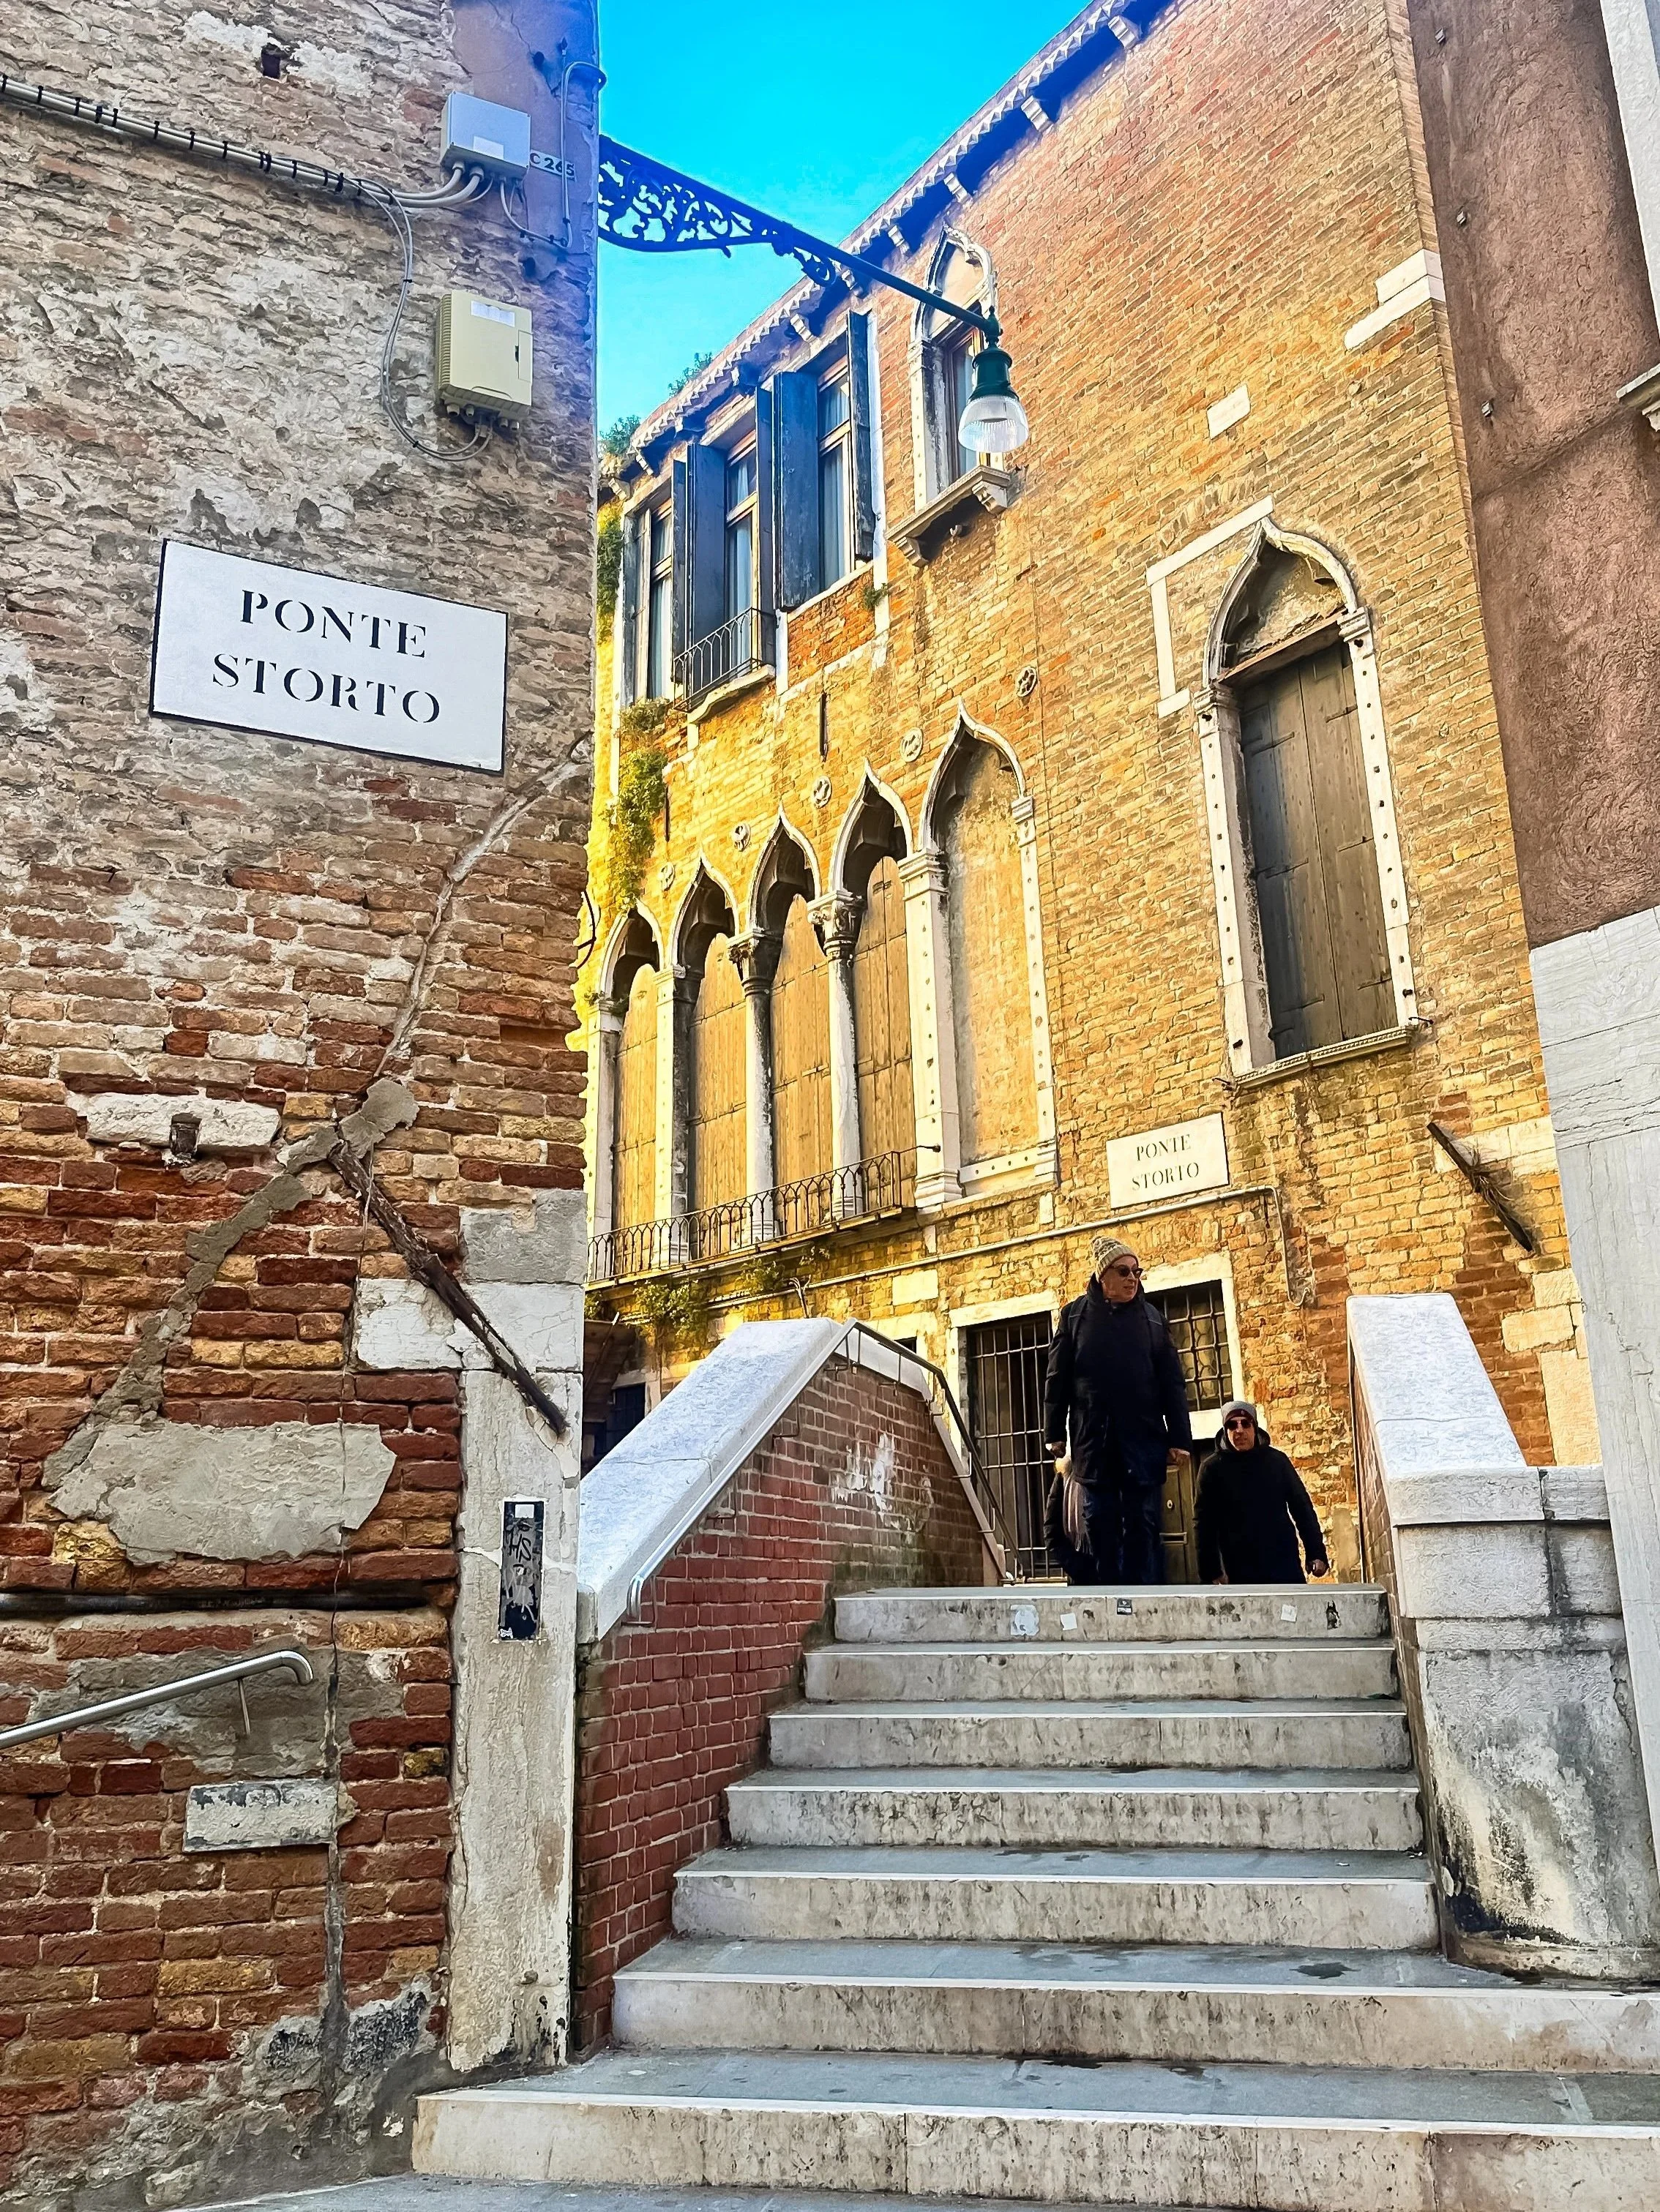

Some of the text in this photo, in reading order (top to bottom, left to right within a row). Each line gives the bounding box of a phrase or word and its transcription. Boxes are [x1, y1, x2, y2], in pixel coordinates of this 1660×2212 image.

[240, 590, 427, 658] PONTE
[212, 653, 441, 724] STORTO
[1137, 1133, 1191, 1161] PONTE
[1132, 1162, 1200, 1191] STORTO
